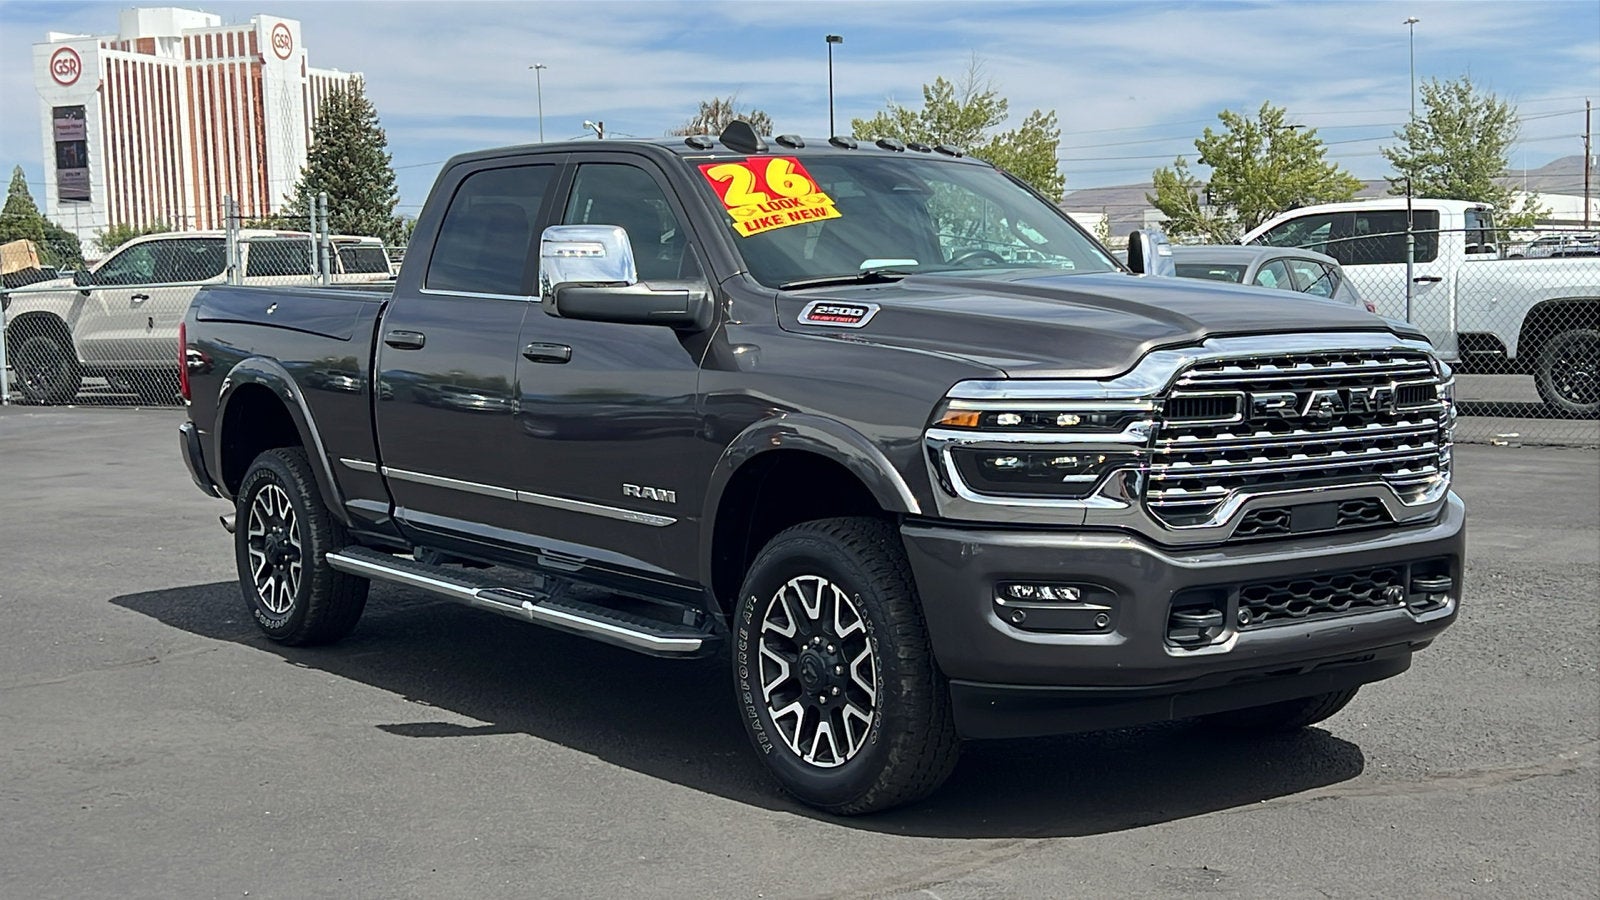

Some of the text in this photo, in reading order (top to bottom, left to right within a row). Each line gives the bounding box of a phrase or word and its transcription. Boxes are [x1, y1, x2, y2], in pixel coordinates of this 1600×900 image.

[274, 33, 290, 50] GSR
[54, 59, 77, 76] GSR
[706, 157, 815, 207] 26
[757, 197, 803, 213] LOOK
[744, 206, 827, 232] LIKE NEW
[815, 305, 864, 317] 2500
[1250, 387, 1393, 419] RAM
[622, 483, 676, 503] RAM
[737, 627, 773, 754] TRANSFORCE
